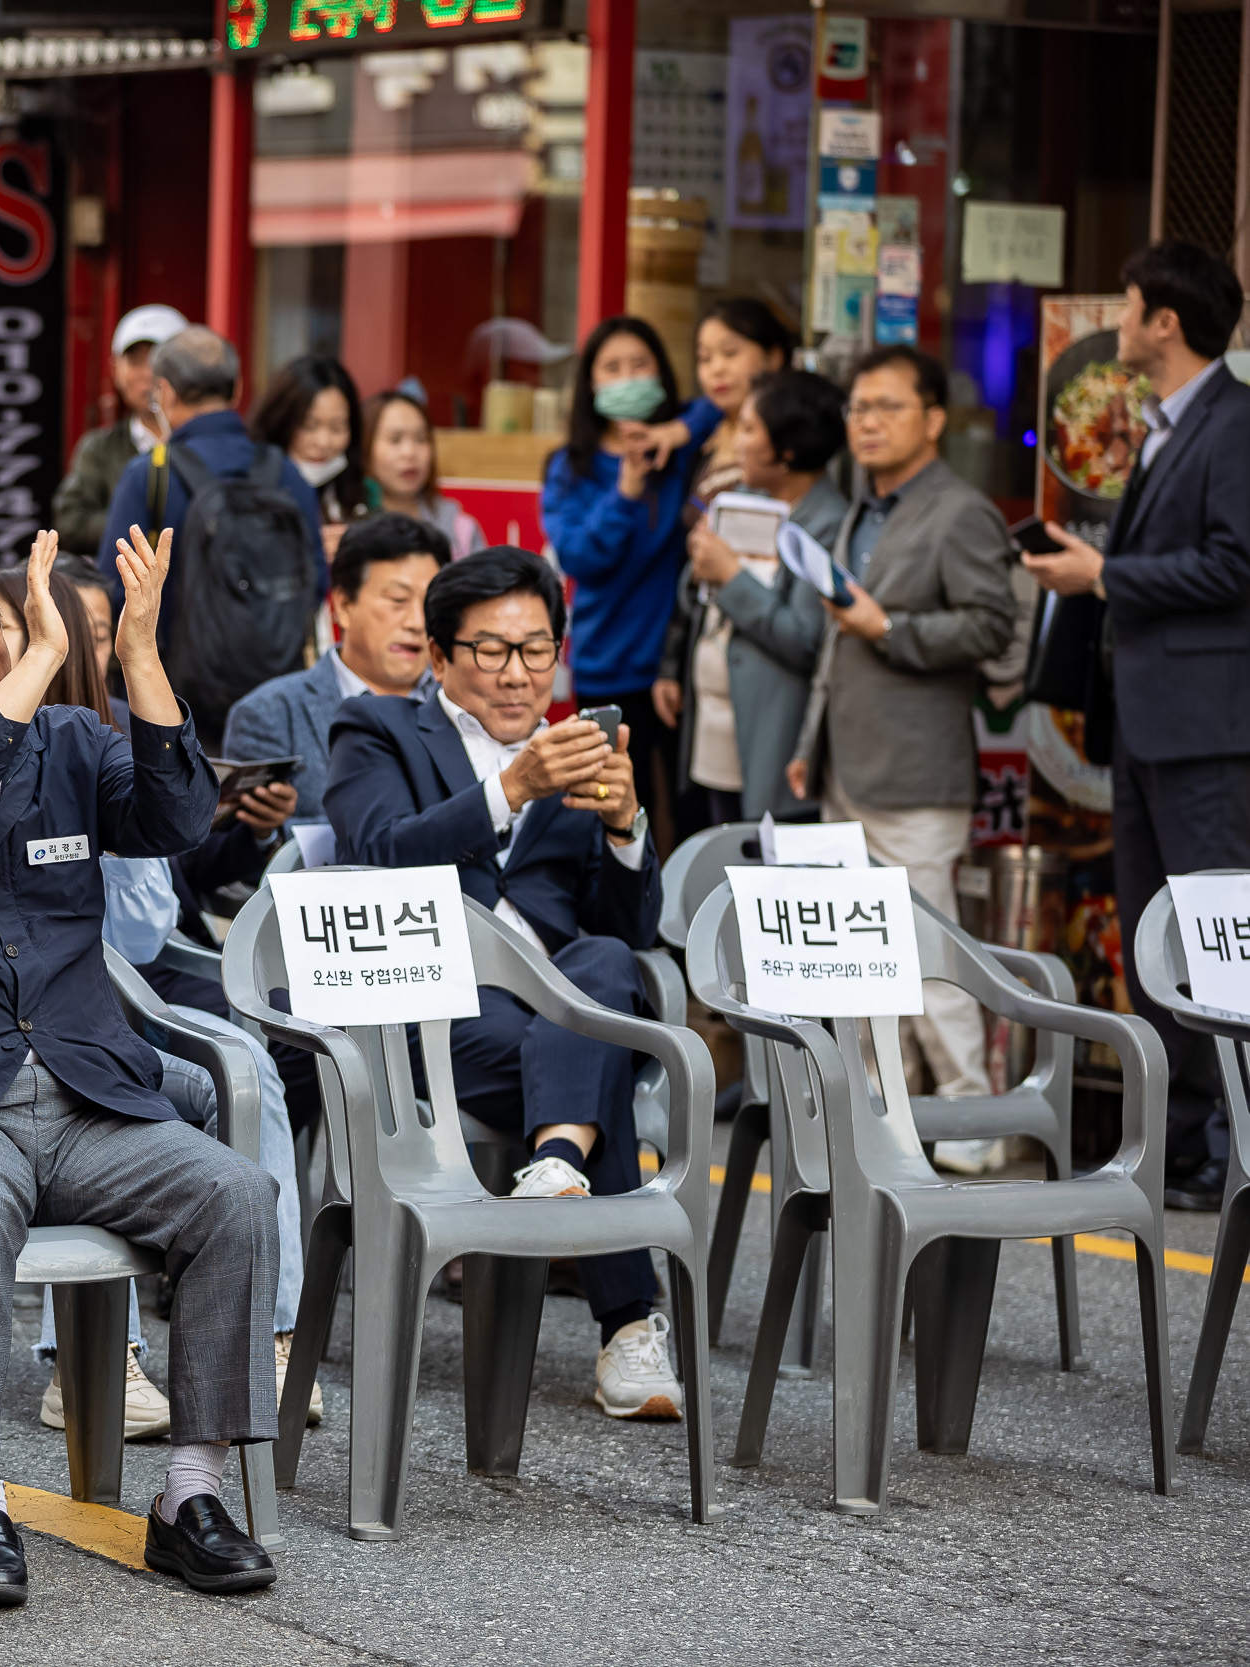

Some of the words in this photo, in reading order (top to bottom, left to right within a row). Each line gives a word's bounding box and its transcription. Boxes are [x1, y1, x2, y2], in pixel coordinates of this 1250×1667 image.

[300, 900, 441, 953] 내빈석
[756, 898, 889, 946] 내빈석
[313, 969, 353, 986] 오신환
[360, 965, 443, 986] 당협위원장
[761, 958, 794, 977] 추윤구
[798, 961, 862, 979] 광진구의회
[868, 960, 898, 978] 의장
